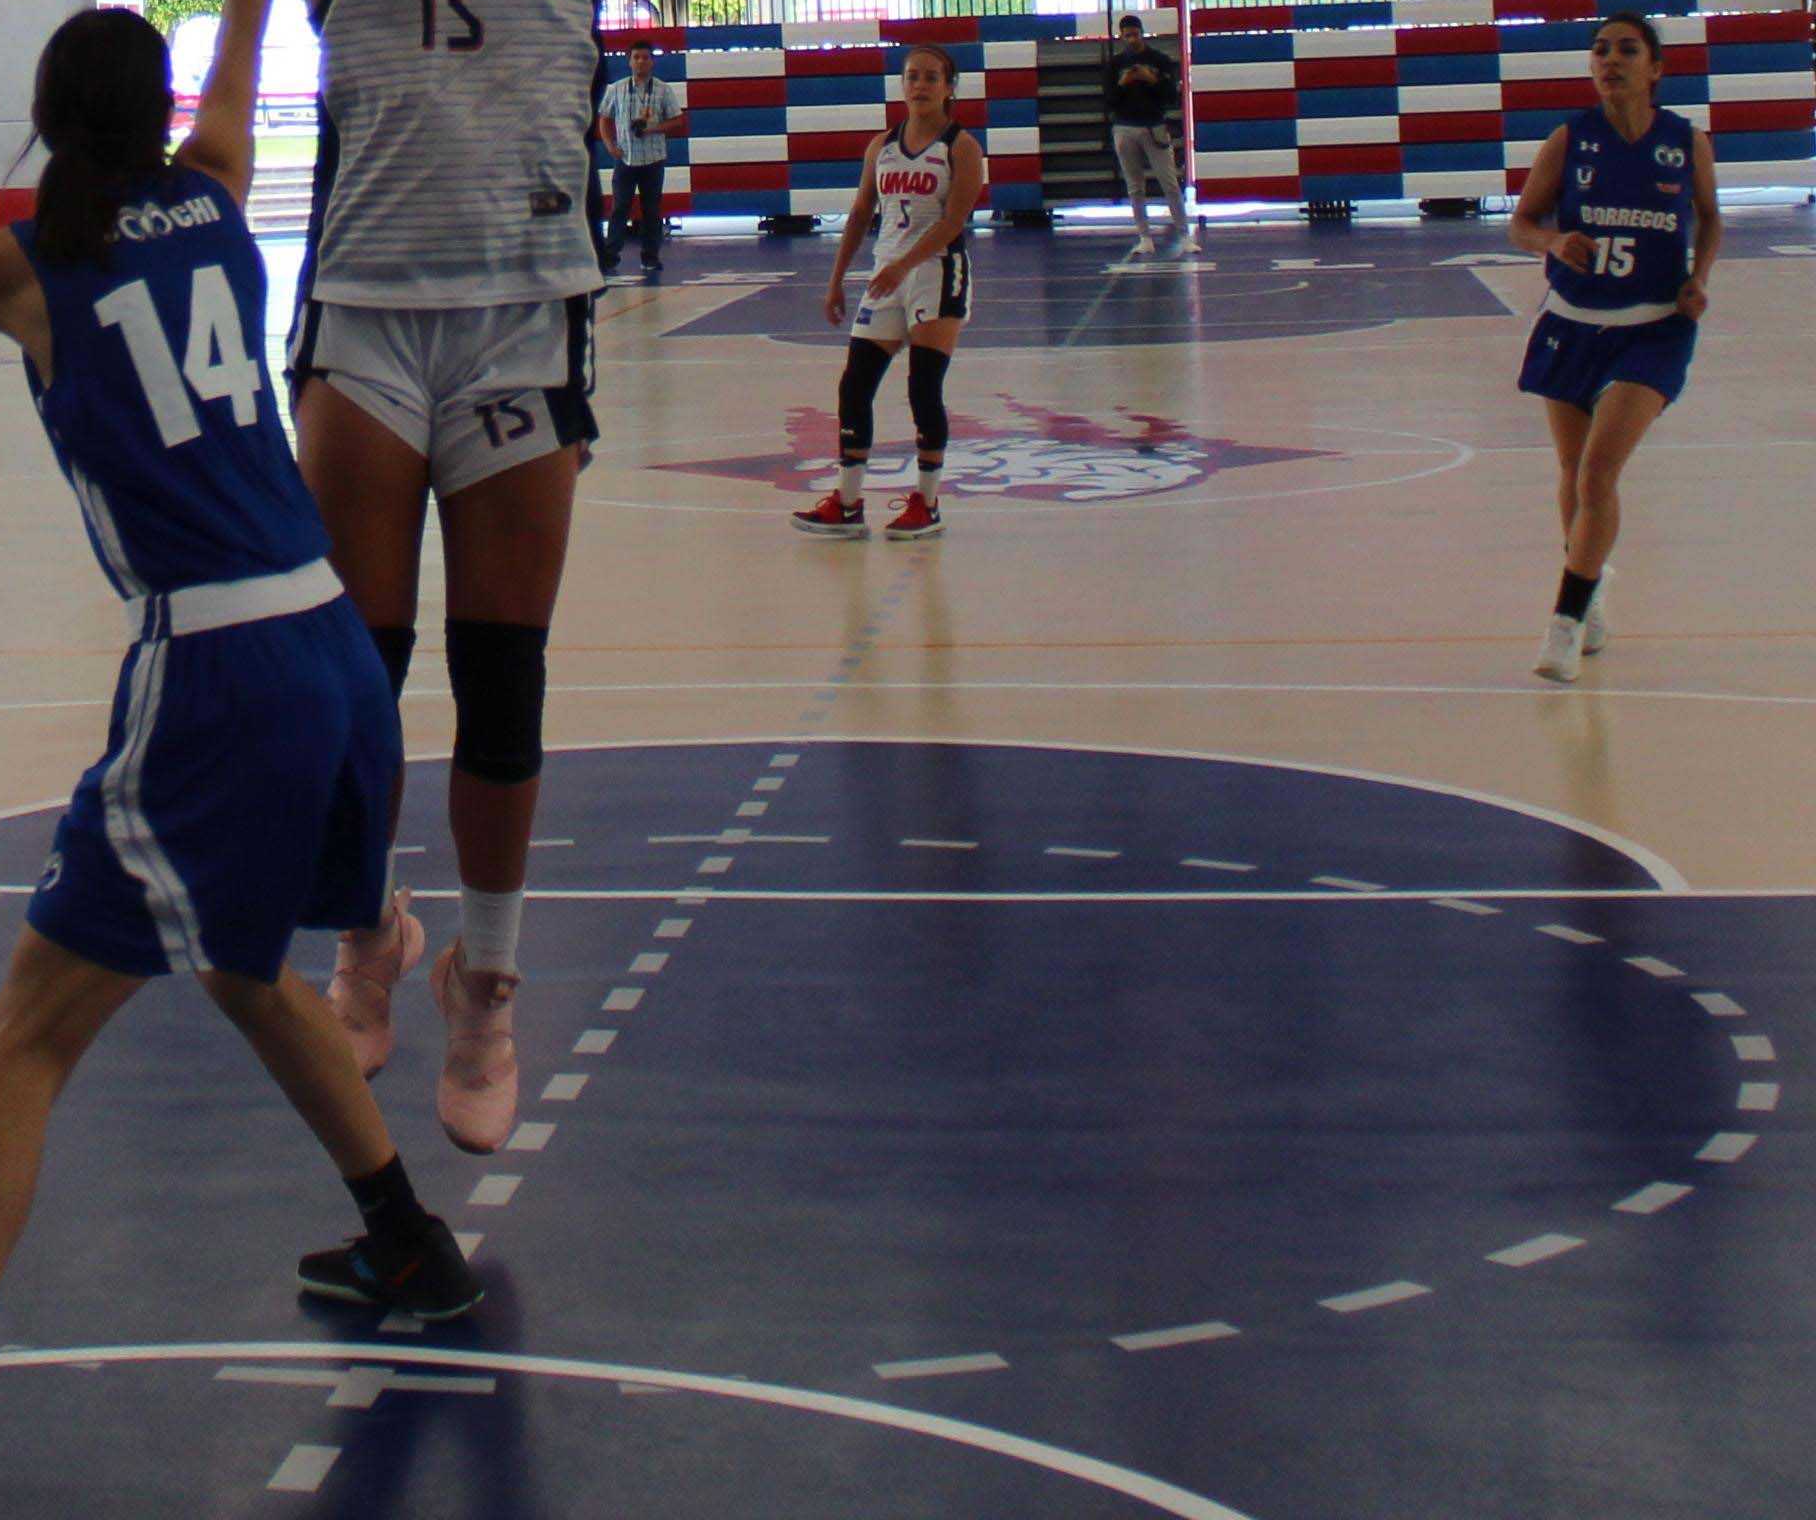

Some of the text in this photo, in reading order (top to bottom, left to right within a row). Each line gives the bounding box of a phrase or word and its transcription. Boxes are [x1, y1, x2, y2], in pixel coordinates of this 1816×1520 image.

[880, 171, 938, 195] UMAD
[897, 199, 912, 228] 5
[1580, 205, 1678, 232] BORREGOS
[1593, 236, 1637, 277] 15
[93, 263, 262, 449] 14
[474, 398, 536, 449] 15
